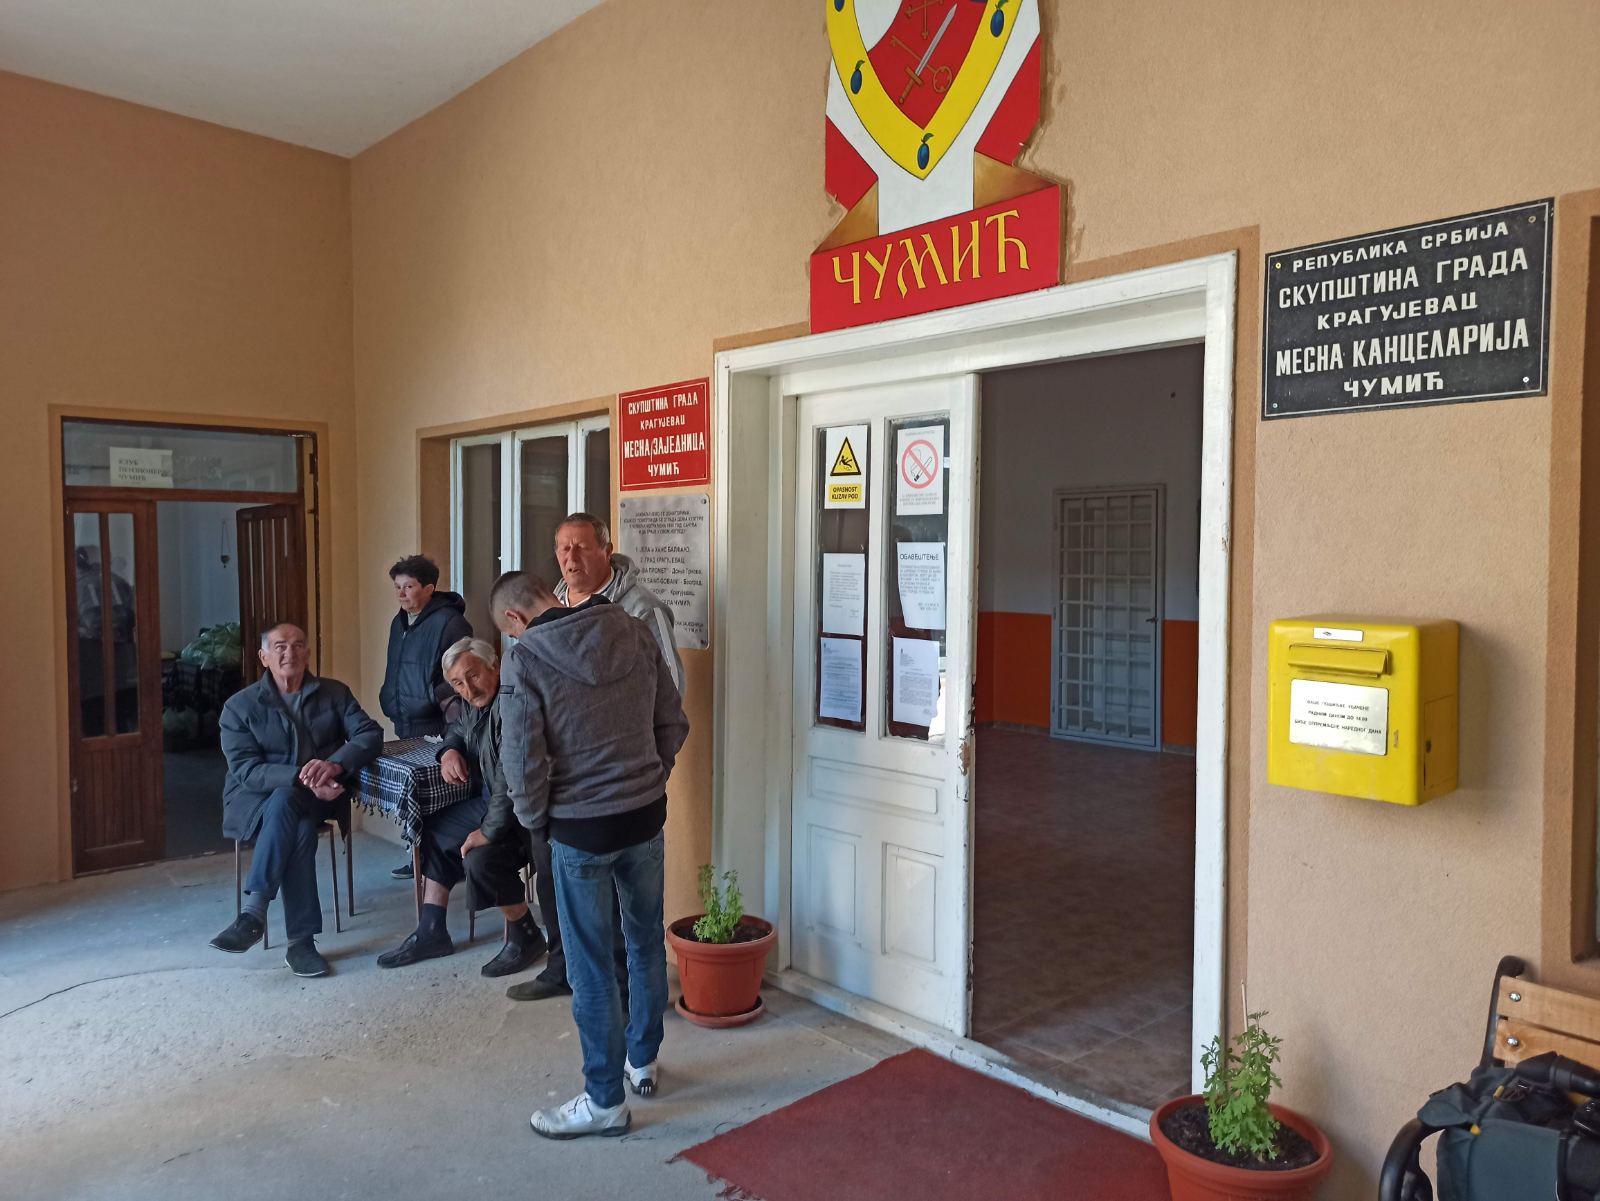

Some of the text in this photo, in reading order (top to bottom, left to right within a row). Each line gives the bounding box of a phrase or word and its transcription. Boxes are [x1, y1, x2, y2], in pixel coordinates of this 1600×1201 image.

[832, 209, 1030, 304] ЧУМИЋ
[1292, 221, 1509, 273] РЕПУБЛИКА СРБИЈА
[1278, 247, 1529, 309] СКУПШТИНА ГРАДА
[1317, 291, 1478, 331] КРАГУЈЕВАЦ
[1275, 318, 1529, 377] МЕСНА КАНЦЕЛАРИЈА
[1343, 371, 1444, 398] ЧУМИЋ
[628, 391, 698, 415] СКУПШТИНА ГРАДА
[640, 414, 686, 431] КРАГУЈЕВАЦ
[624, 431, 705, 459] МЕСНА ЗАЈЕДНИЦА
[648, 462, 680, 477] ЧУМИЋ
[832, 486, 858, 494] OPASNOST
